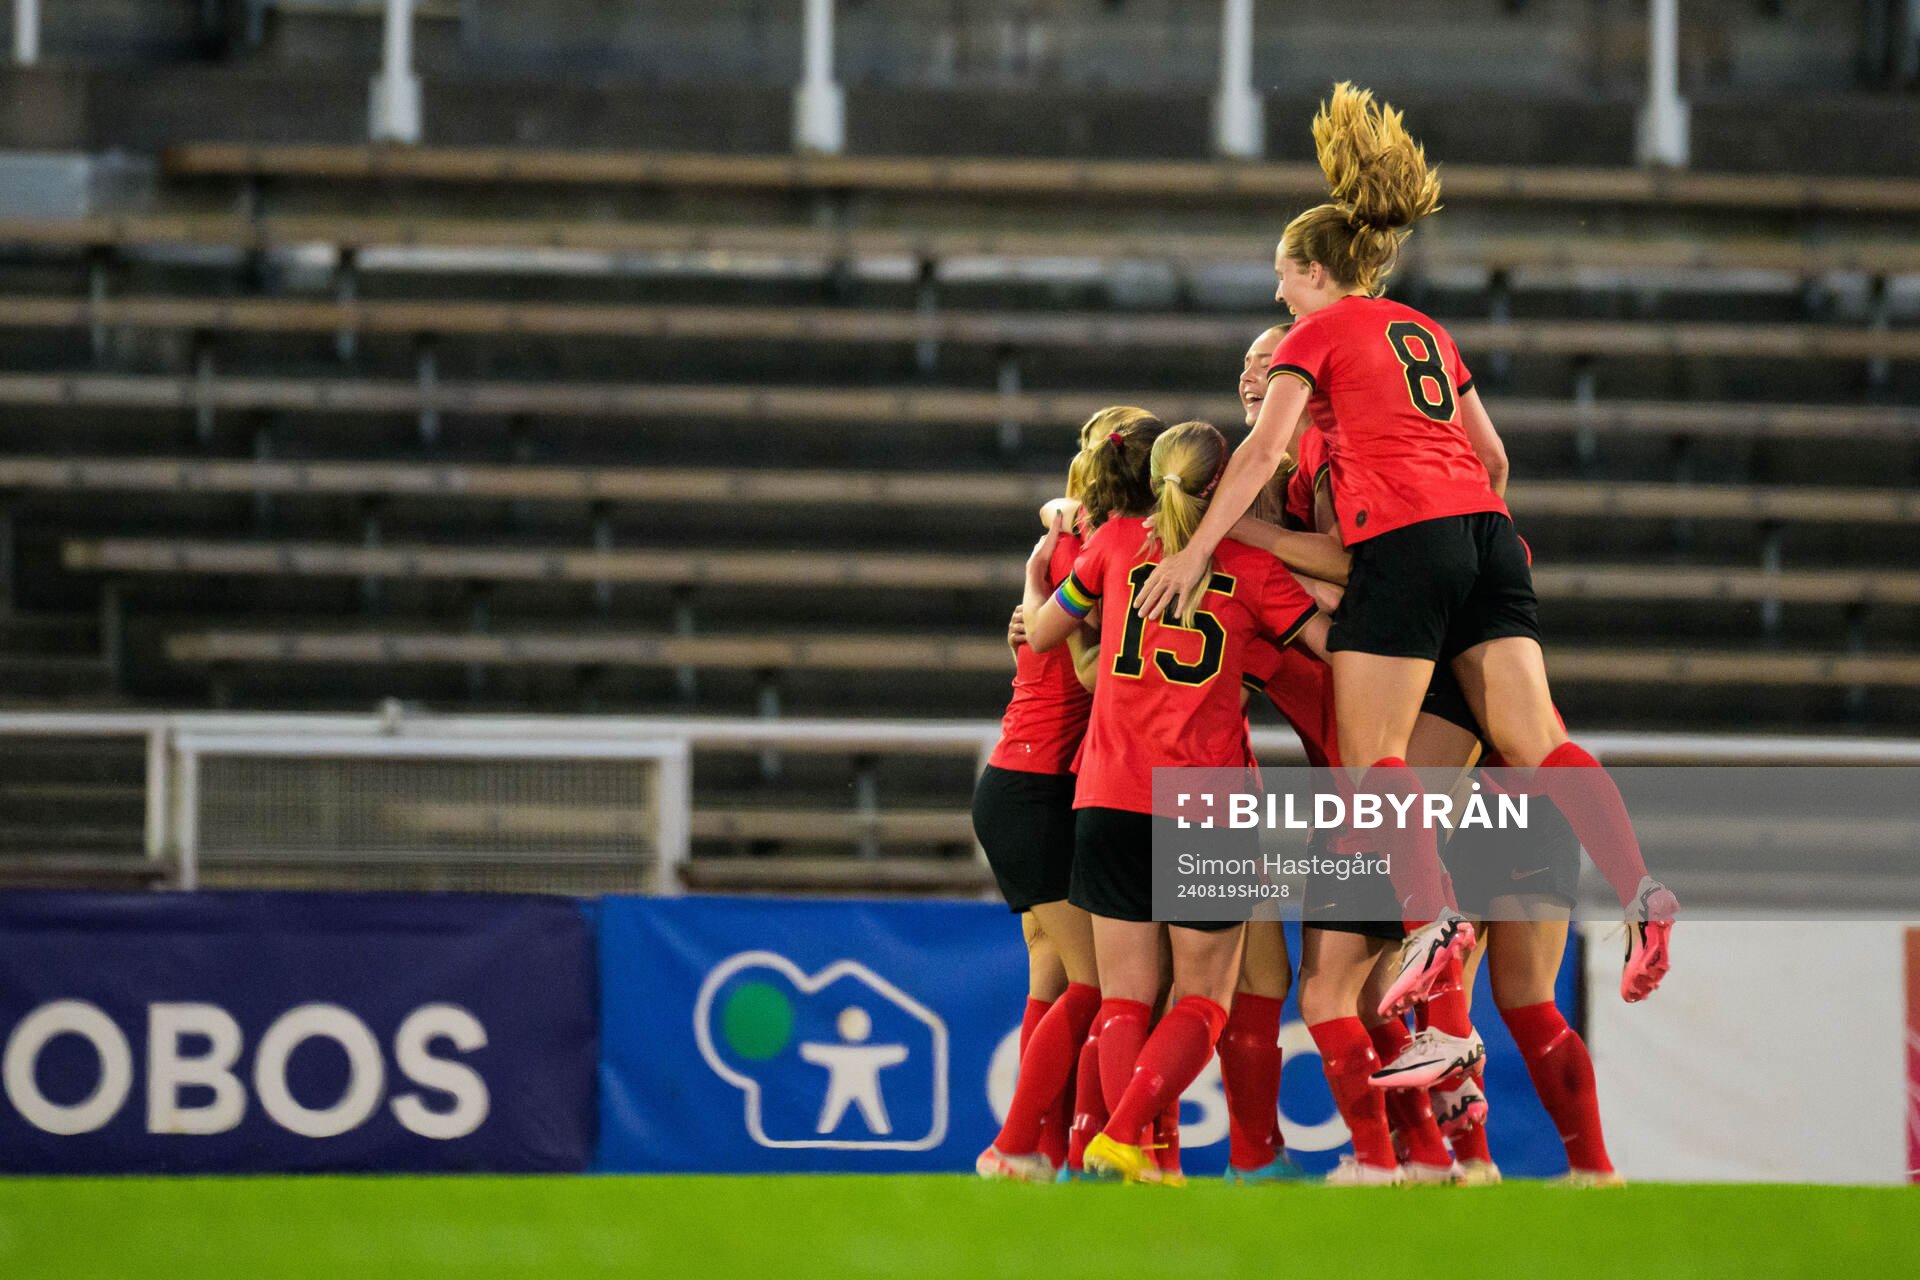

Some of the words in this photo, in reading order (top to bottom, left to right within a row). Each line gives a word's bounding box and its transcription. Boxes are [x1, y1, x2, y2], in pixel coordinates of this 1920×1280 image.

[1385, 321, 1456, 422] 8
[1111, 561, 1237, 688] 15
[3, 1000, 490, 1139] OBOS
